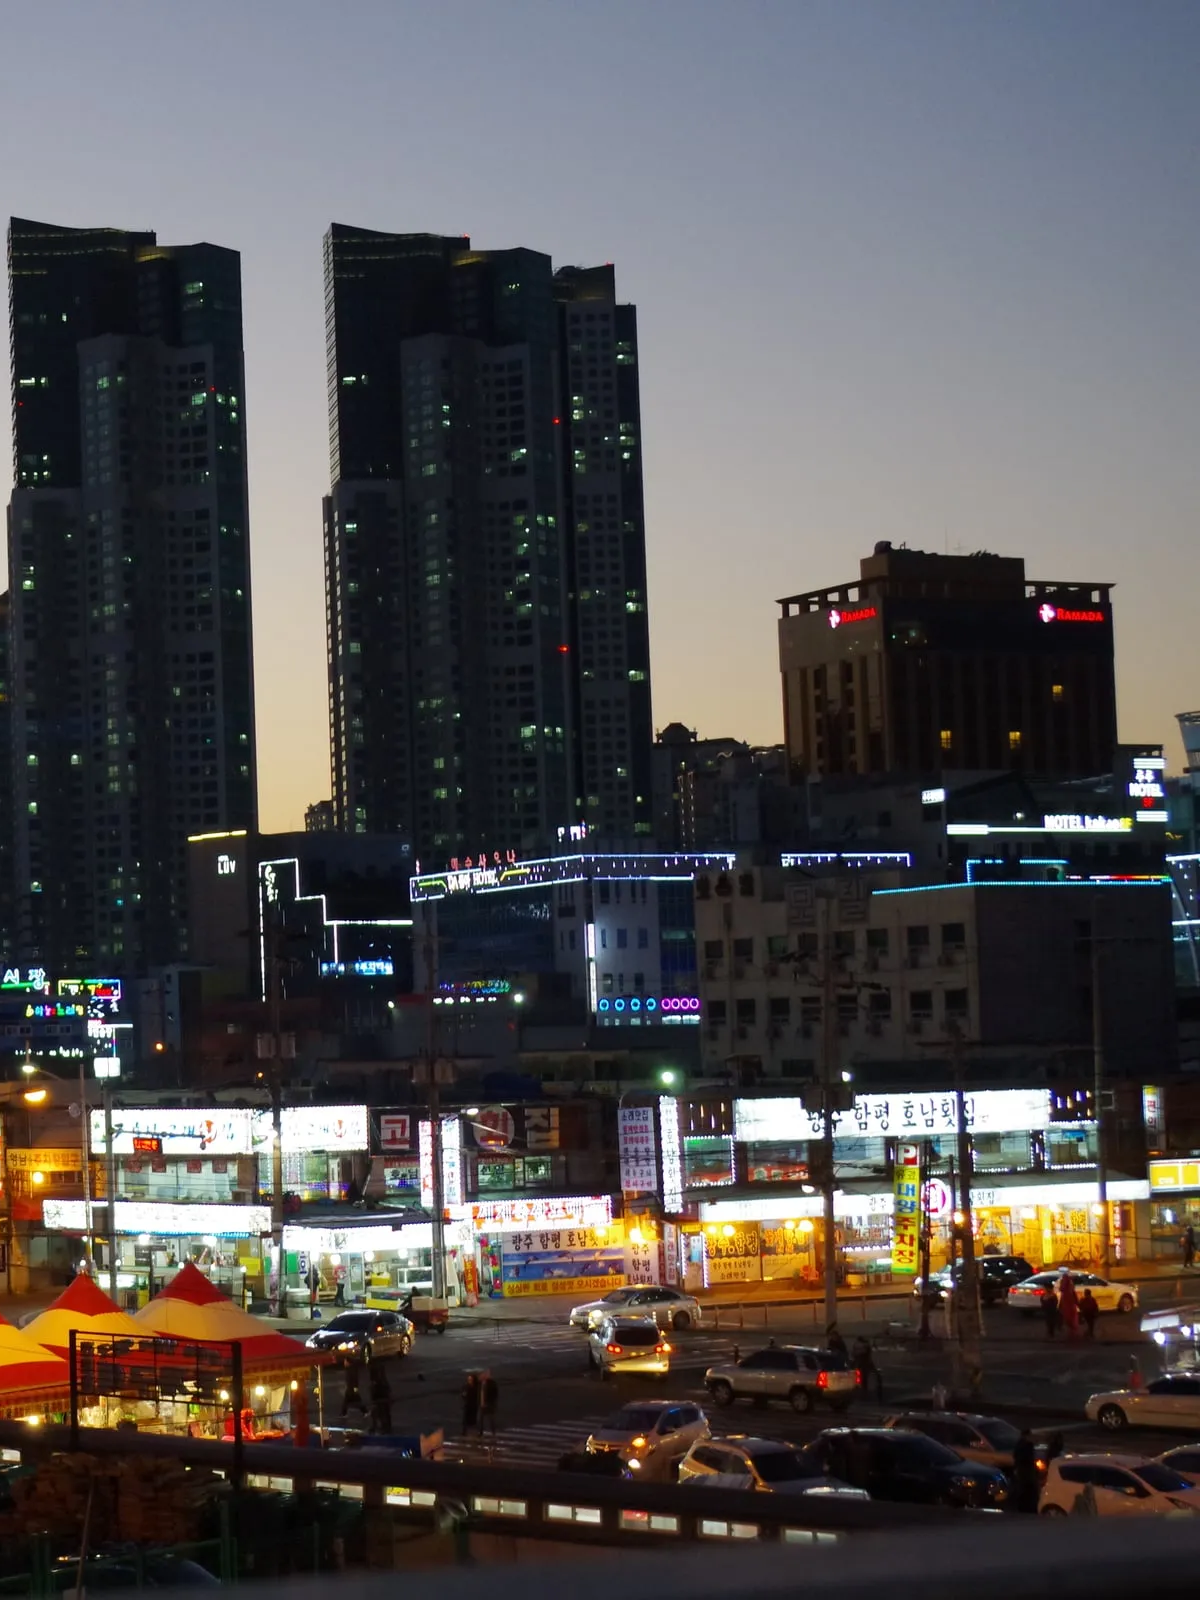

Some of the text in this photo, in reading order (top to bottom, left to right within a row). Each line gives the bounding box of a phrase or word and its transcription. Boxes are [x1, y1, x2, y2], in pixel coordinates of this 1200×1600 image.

[841, 607, 877, 624] RAMADA
[1056, 609, 1104, 622] RAMADA
[1128, 783, 1164, 797] MOTEL
[1044, 814, 1084, 829] MOTEL
[897, 1144, 917, 1166] P
[631, 1258, 651, 1272] 함평
